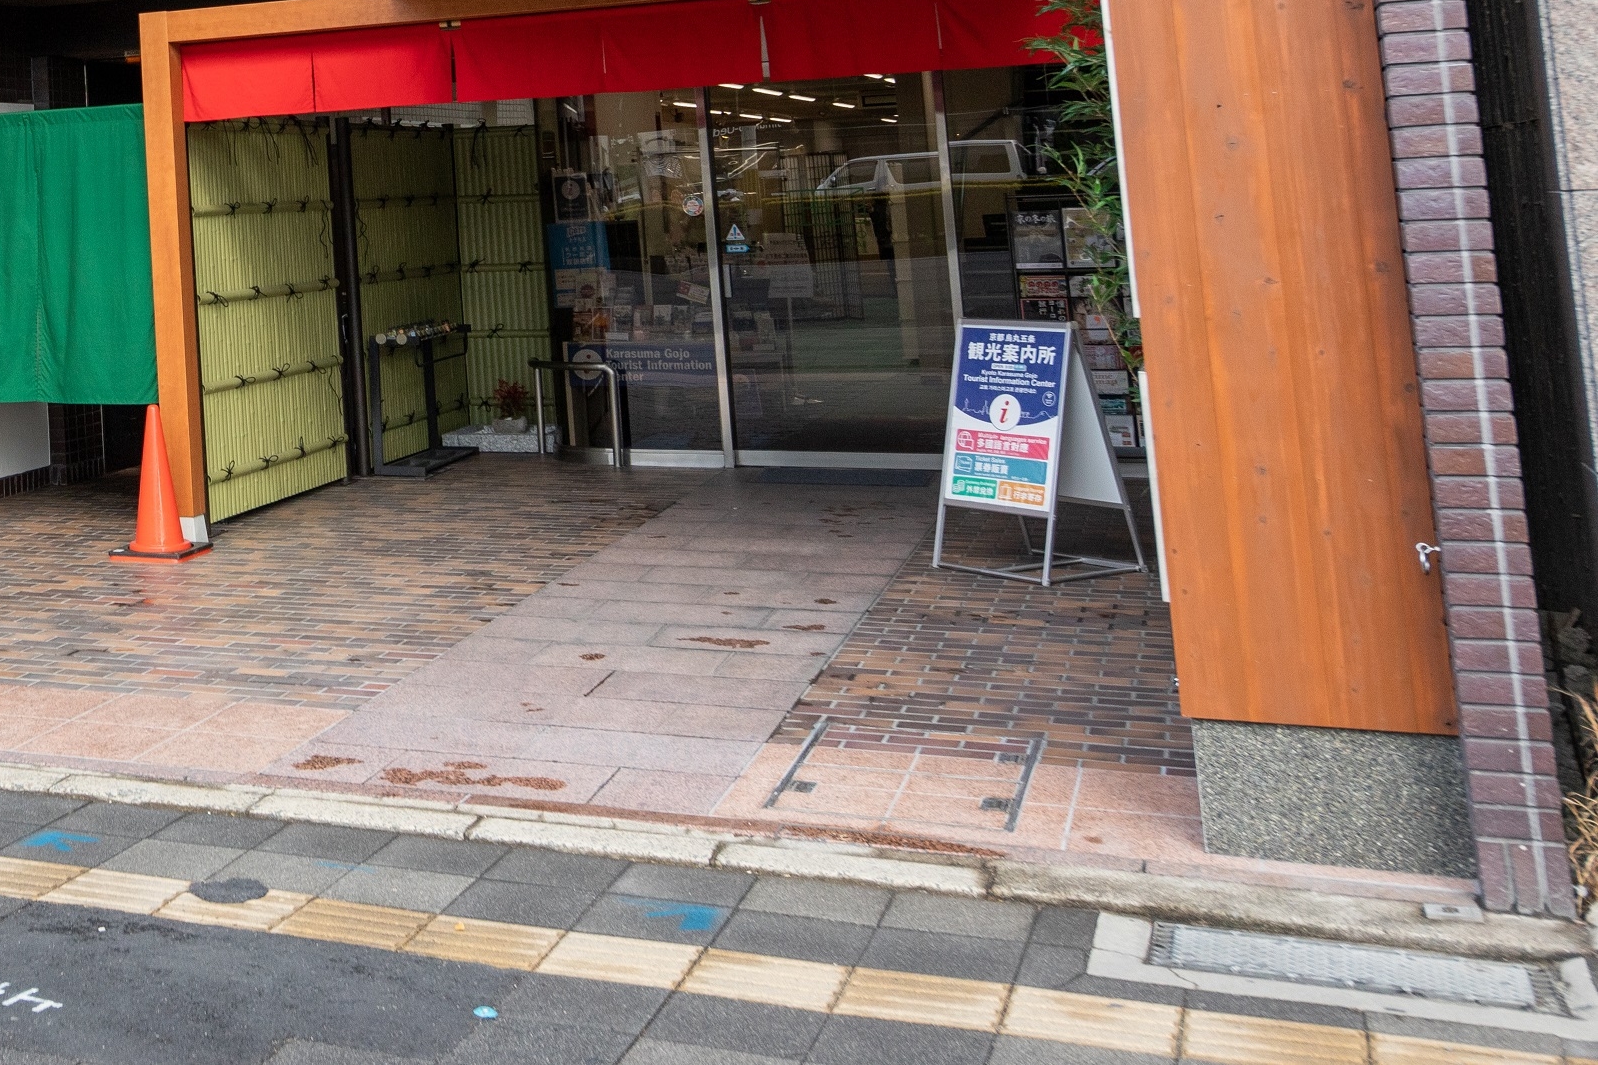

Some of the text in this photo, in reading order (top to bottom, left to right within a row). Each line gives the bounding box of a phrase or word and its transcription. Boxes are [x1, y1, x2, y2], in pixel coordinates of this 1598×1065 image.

[605, 348, 690, 361] Karasuma Gojo
[967, 341, 1057, 366] 観光案内所
[647, 360, 713, 371] Information
[616, 372, 644, 382] enter
[963, 374, 1057, 388] Tourist Information Center
